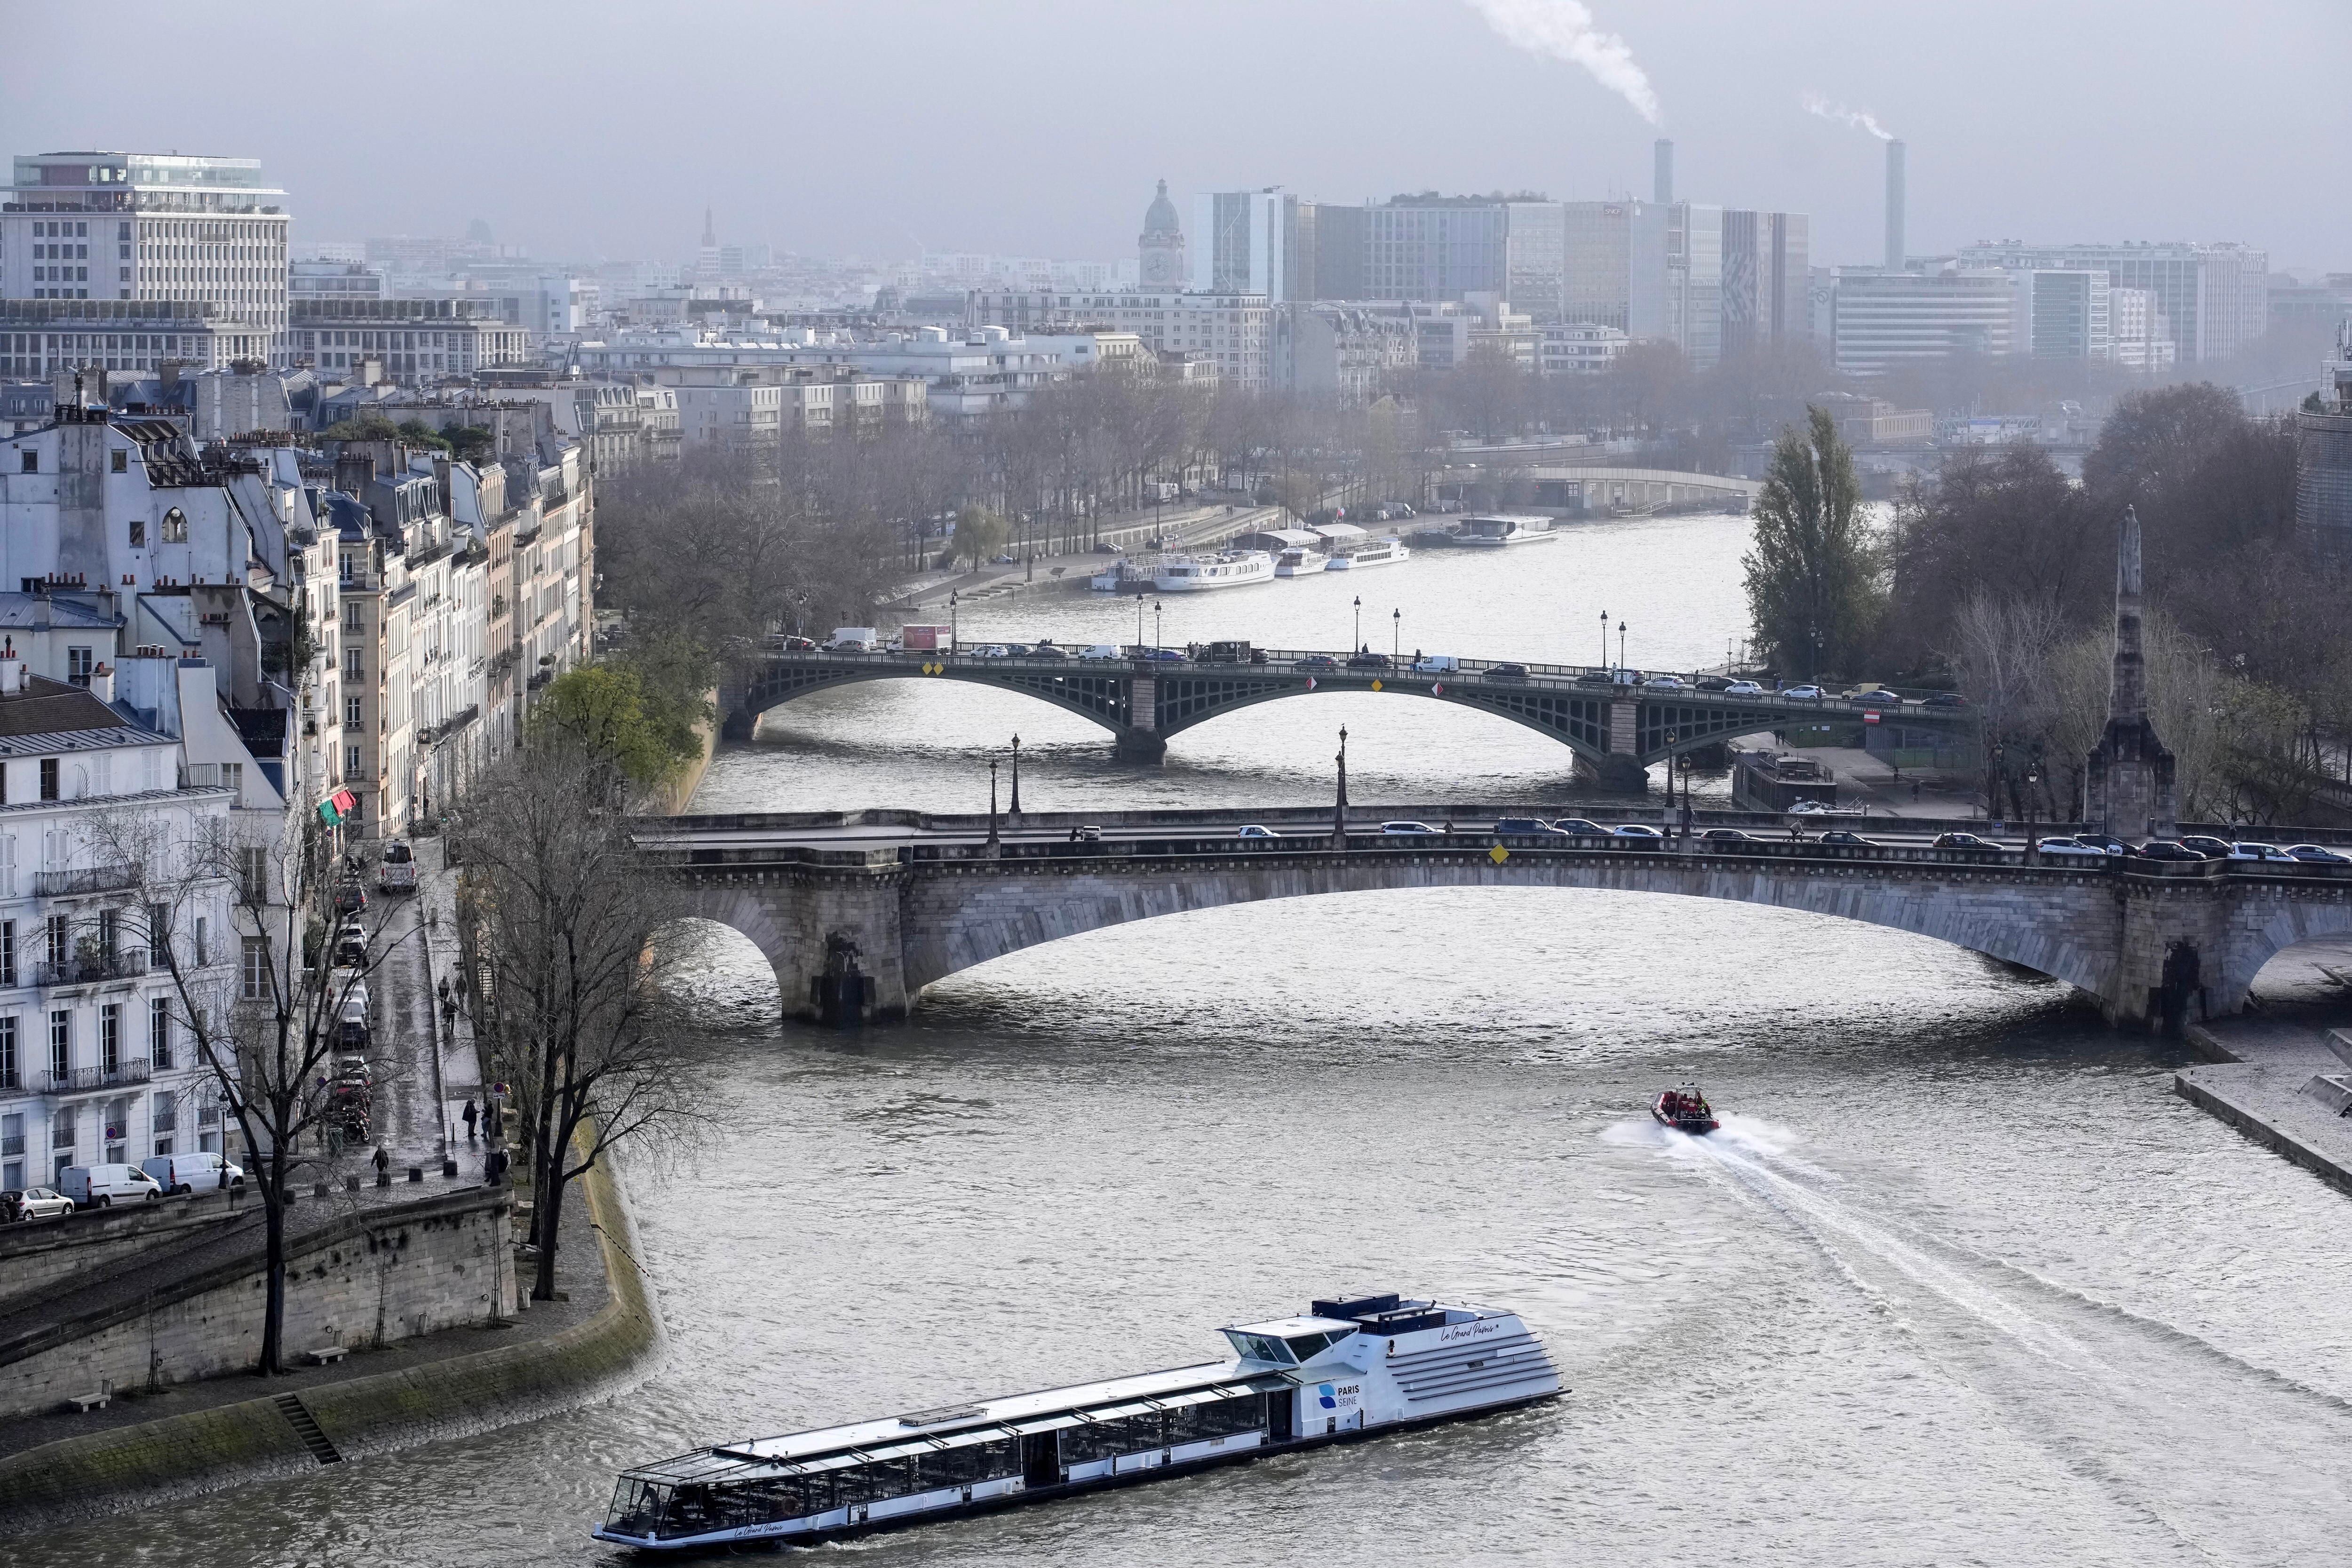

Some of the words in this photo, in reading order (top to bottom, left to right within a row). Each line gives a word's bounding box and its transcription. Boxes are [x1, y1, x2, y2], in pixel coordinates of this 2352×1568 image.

[1441, 1328, 1450, 1341] Le
[1451, 1326, 1472, 1340] Grand
[1473, 1322, 1494, 1337] Pavois
[1338, 1385, 1359, 1396] PARIS
[1338, 1396, 1357, 1407] SEINE
[734, 1528, 742, 1537] Le
[744, 1525, 763, 1536] Grand
